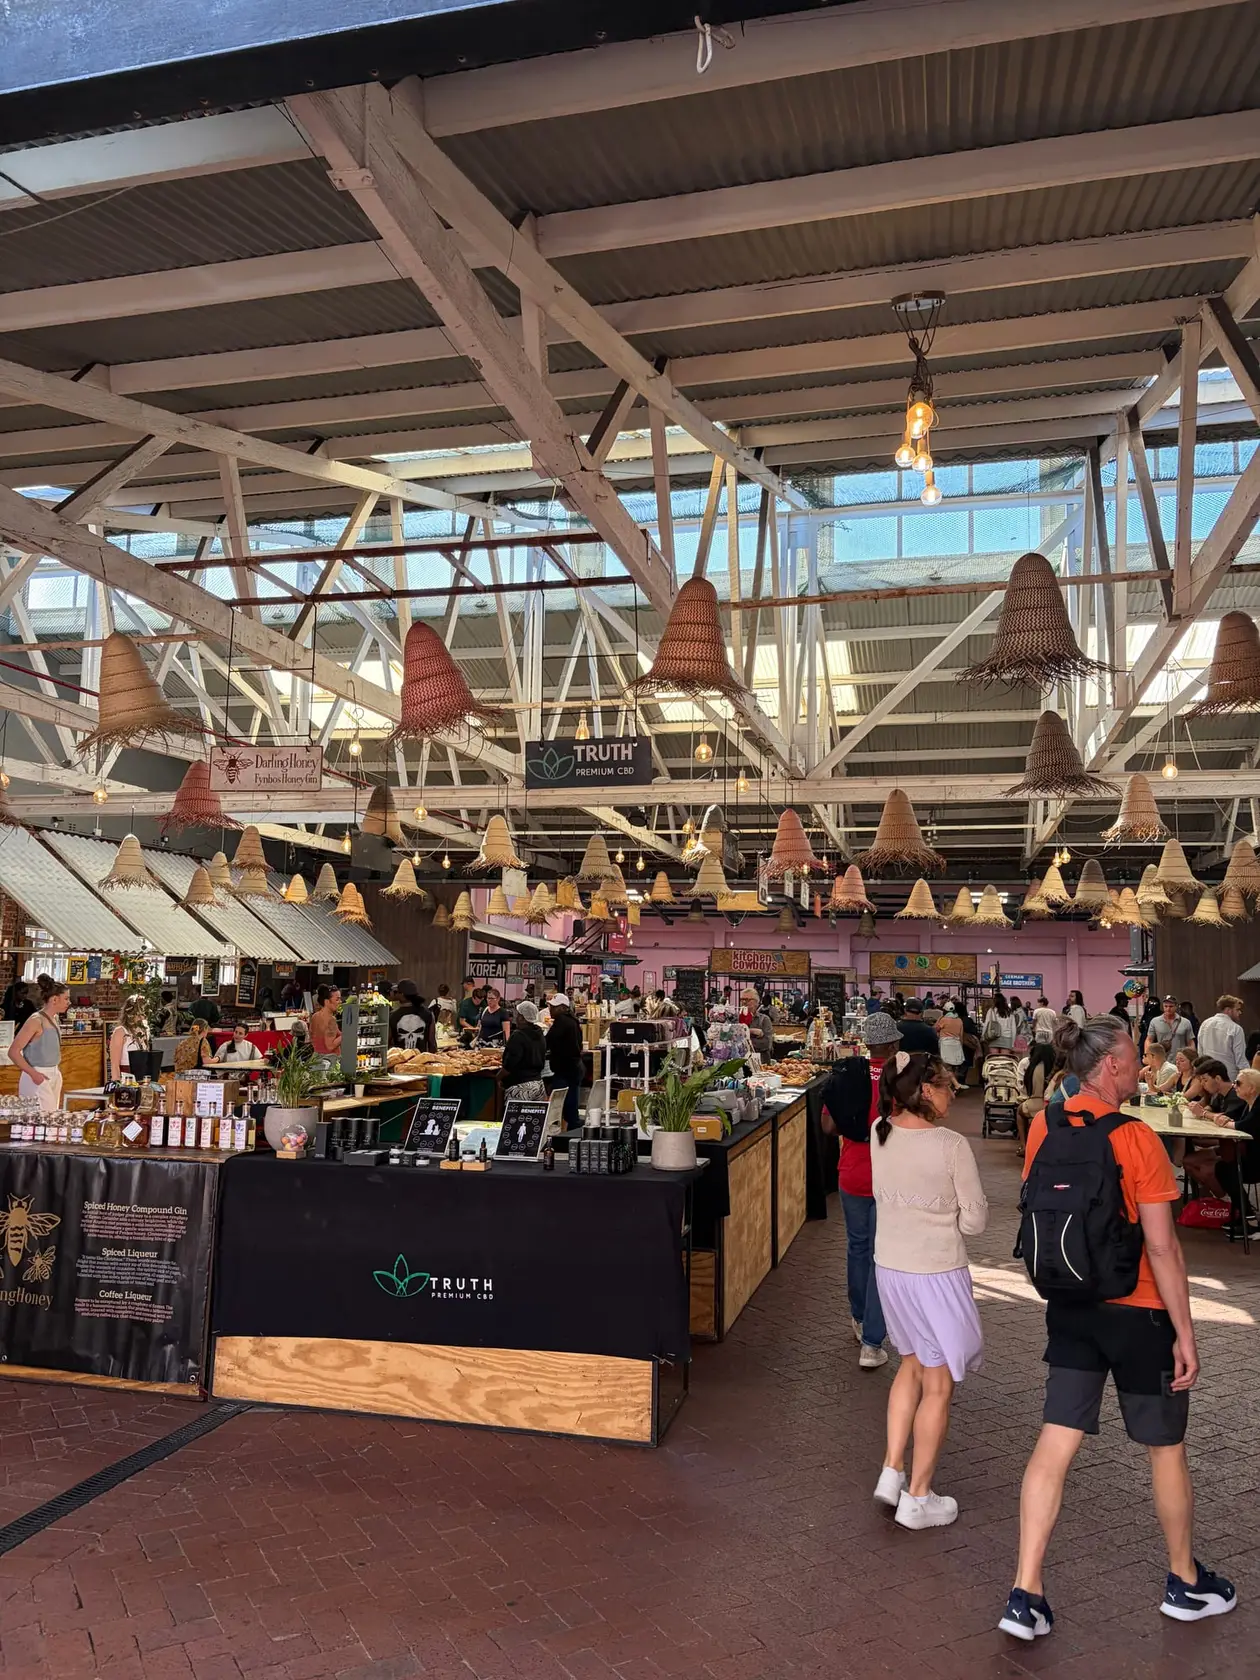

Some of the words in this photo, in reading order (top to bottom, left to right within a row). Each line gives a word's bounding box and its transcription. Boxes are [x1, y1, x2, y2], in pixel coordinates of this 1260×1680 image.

[574, 743, 633, 762] TRUTH
[576, 767, 614, 776] PREMIUM
[617, 766, 634, 775] CBD
[733, 951, 772, 962] kitchen
[733, 960, 777, 972] cowboys
[84, 1201, 106, 1211] Spiced
[106, 1202, 130, 1213] Honey
[131, 1204, 172, 1214] Compound
[173, 1206, 187, 1215] Gin
[101, 1247, 126, 1257] Spiced
[127, 1249, 158, 1258] Liqueur
[430, 1277, 493, 1291] TRUTH
[99, 1289, 124, 1299] Coffee
[124, 1291, 153, 1301] Liqueur
